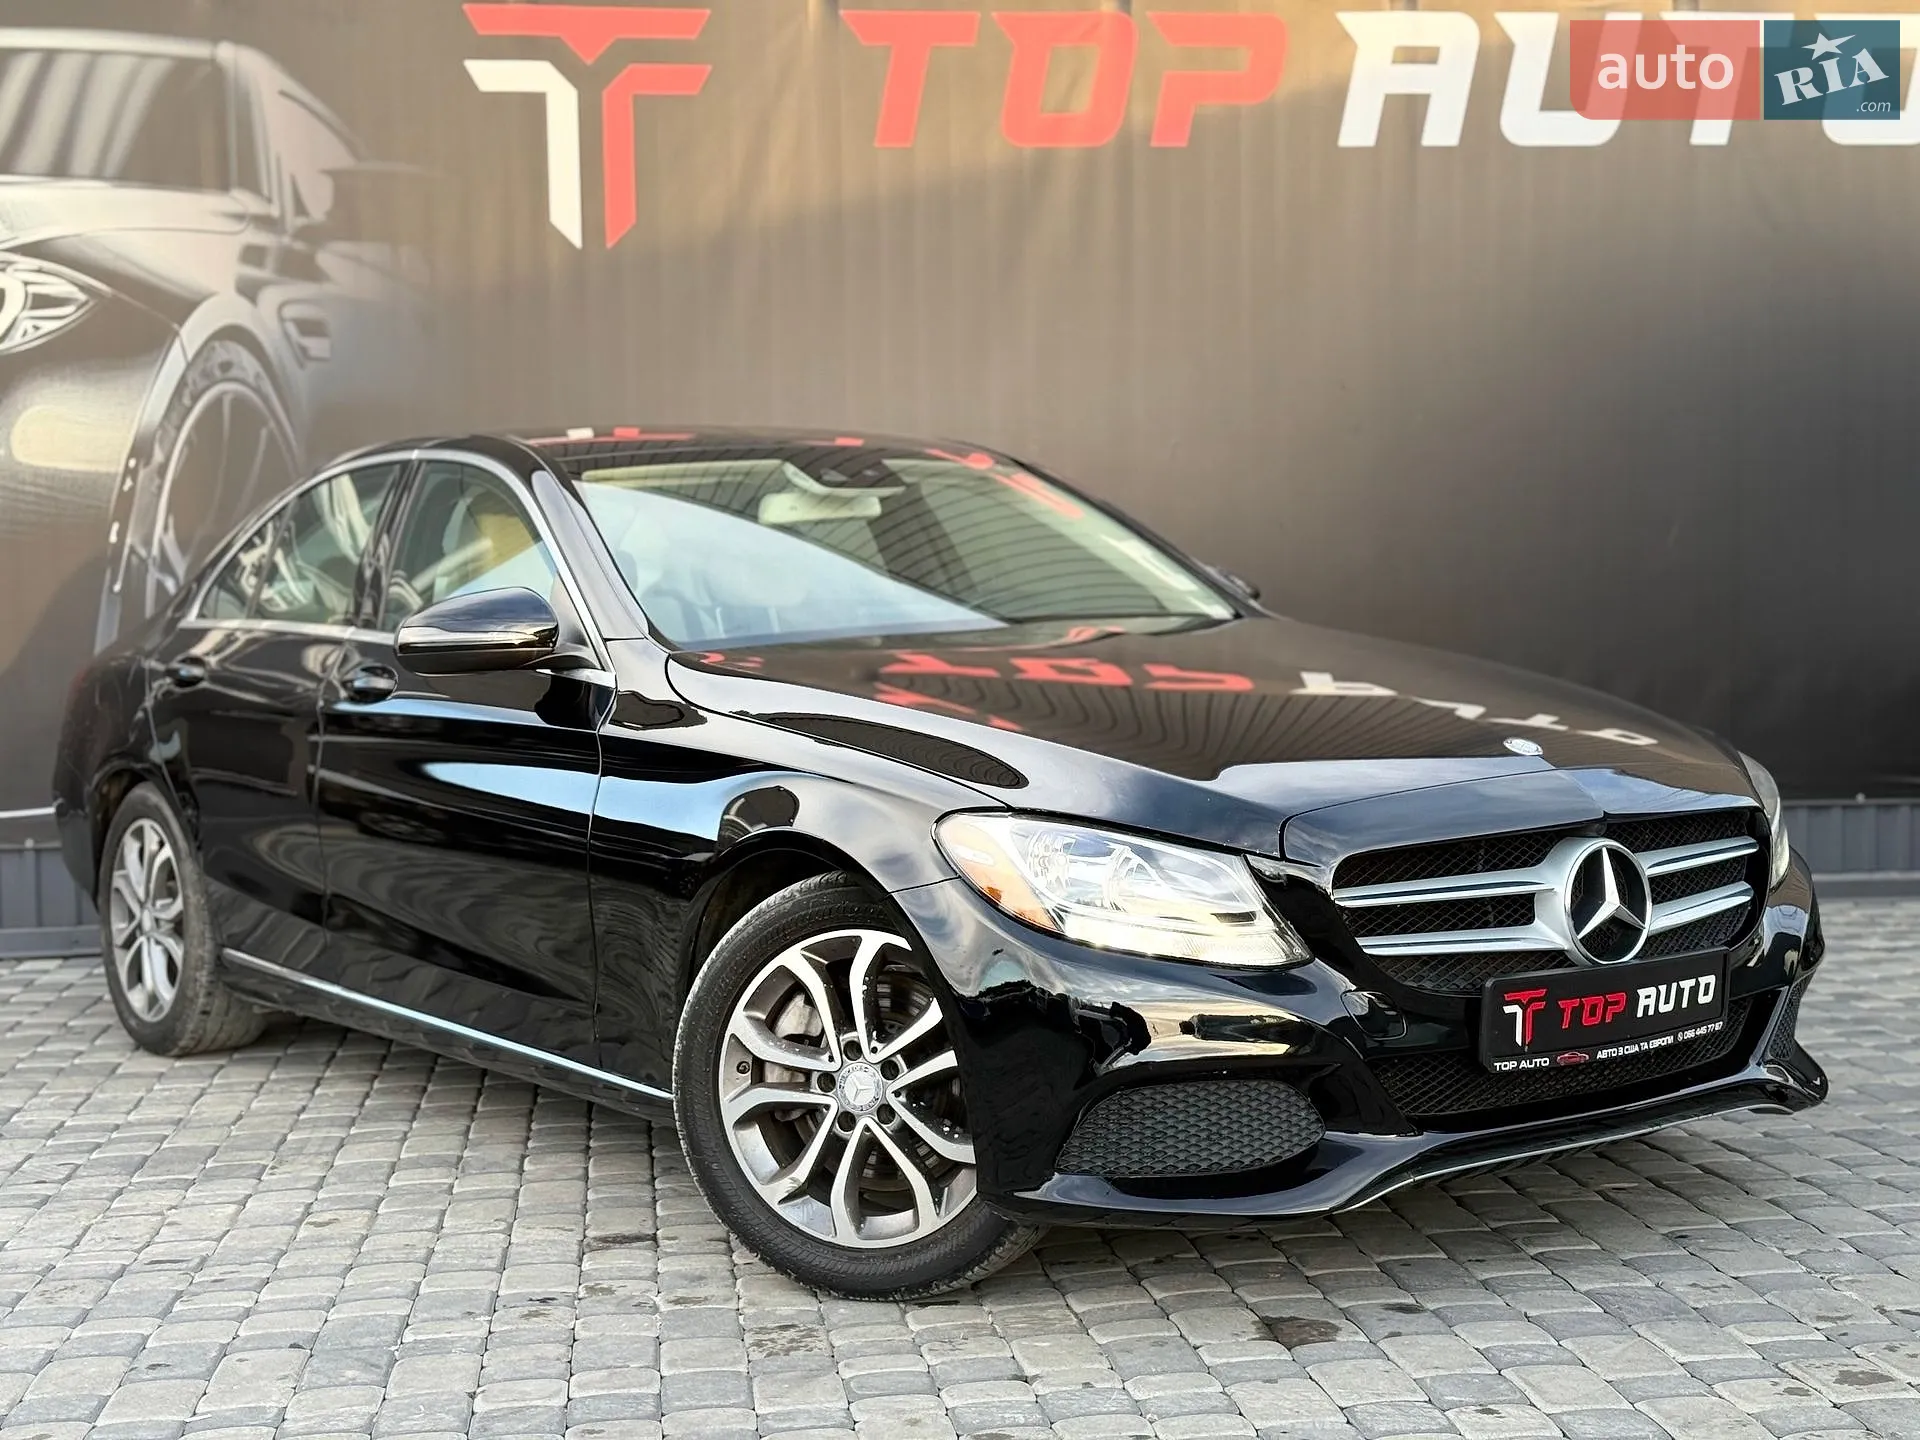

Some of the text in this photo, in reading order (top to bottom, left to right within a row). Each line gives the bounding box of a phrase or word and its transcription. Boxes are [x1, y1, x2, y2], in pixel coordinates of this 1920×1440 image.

[840, 9, 1920, 148] TOP AUTO
[1557, 974, 1716, 1029] TOP AUTO
[1494, 1058, 1549, 1071] TOP AUTO
[1596, 1048, 1617, 1059] АВТО
[1624, 1043, 1640, 1054] США
[1640, 1041, 1649, 1050] ТА
